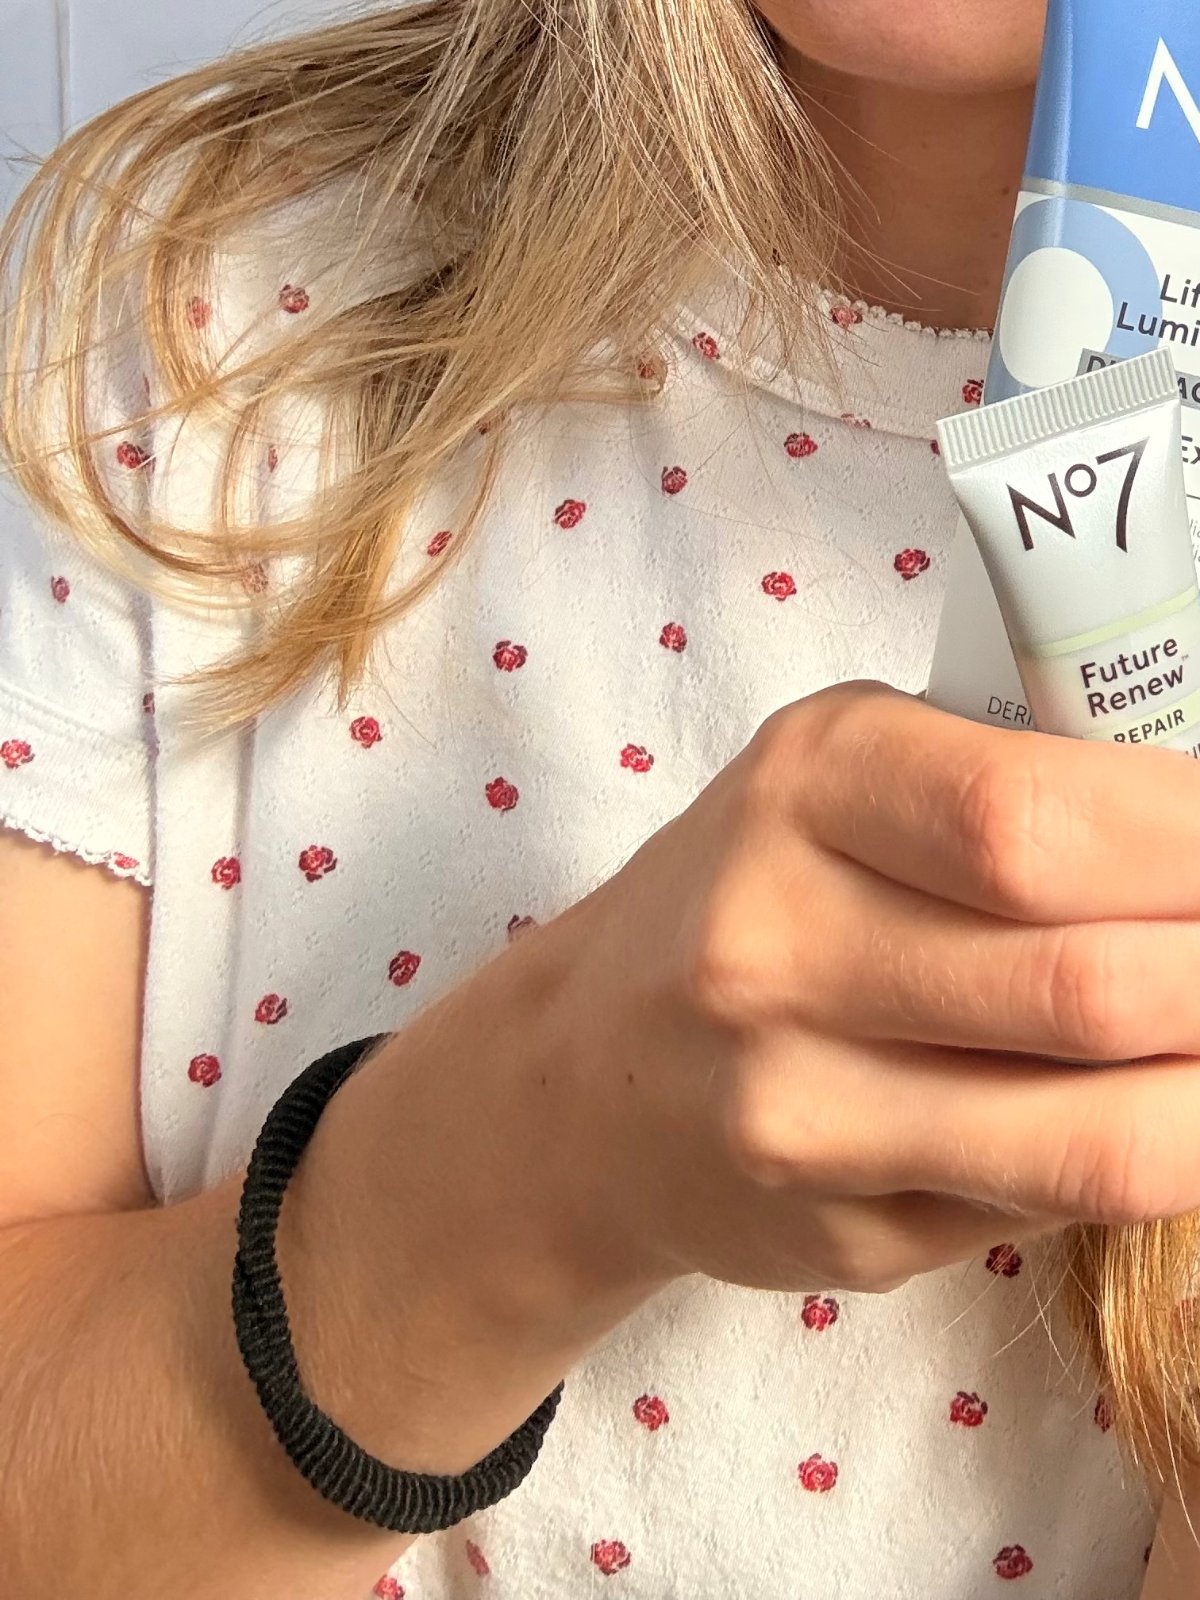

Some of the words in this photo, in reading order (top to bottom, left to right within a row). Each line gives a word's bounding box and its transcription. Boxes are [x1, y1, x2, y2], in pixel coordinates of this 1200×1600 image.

[1079, 638, 1179, 689] Future
[1086, 664, 1184, 718] Renew
[1113, 708, 1186, 744] REPAIR
